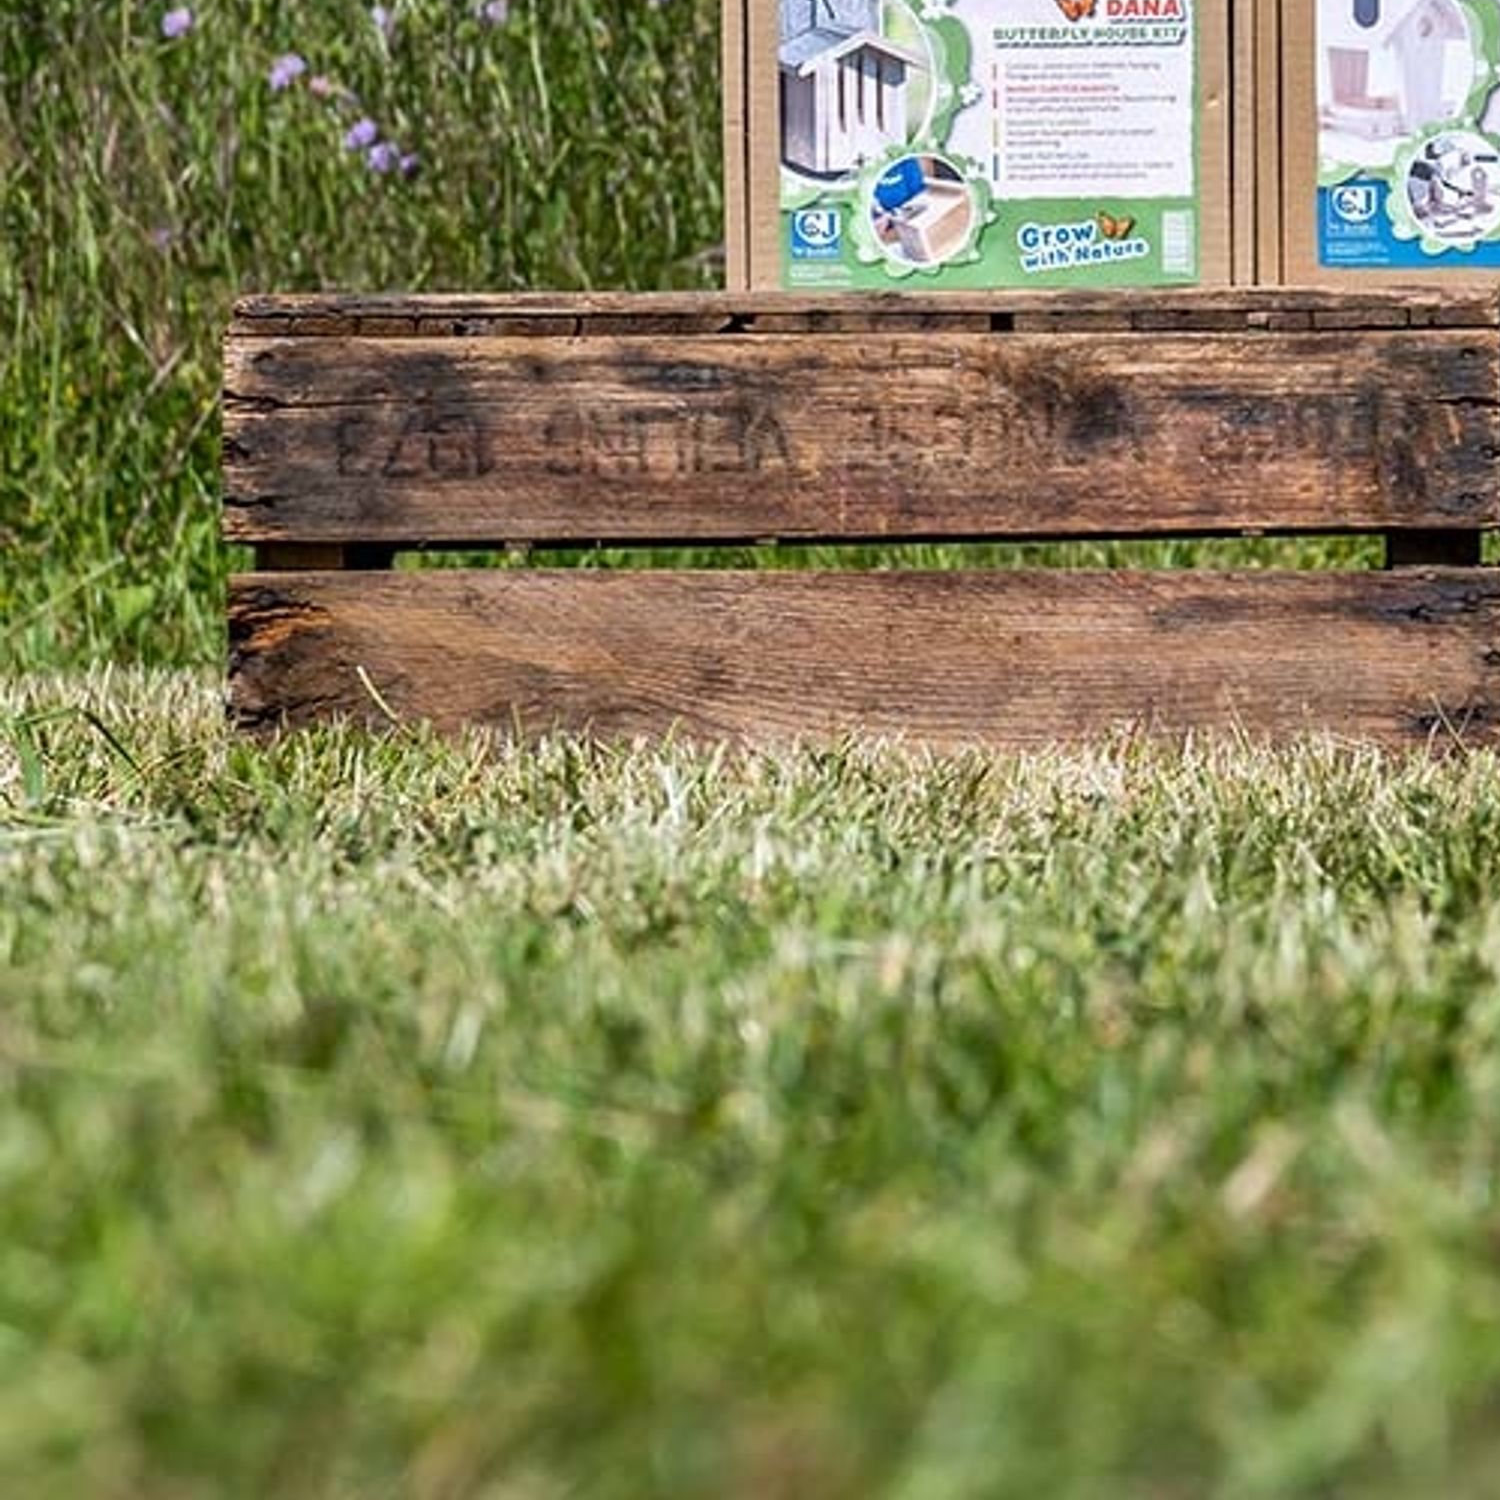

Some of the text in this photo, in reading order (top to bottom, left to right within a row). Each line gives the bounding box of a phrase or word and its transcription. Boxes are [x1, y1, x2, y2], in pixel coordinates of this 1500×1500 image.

[993, 25, 1179, 41] BUTTERFLY HOUSE KIT
[1021, 223, 1094, 248] Grow
[1025, 241, 1145, 268] with Nature
